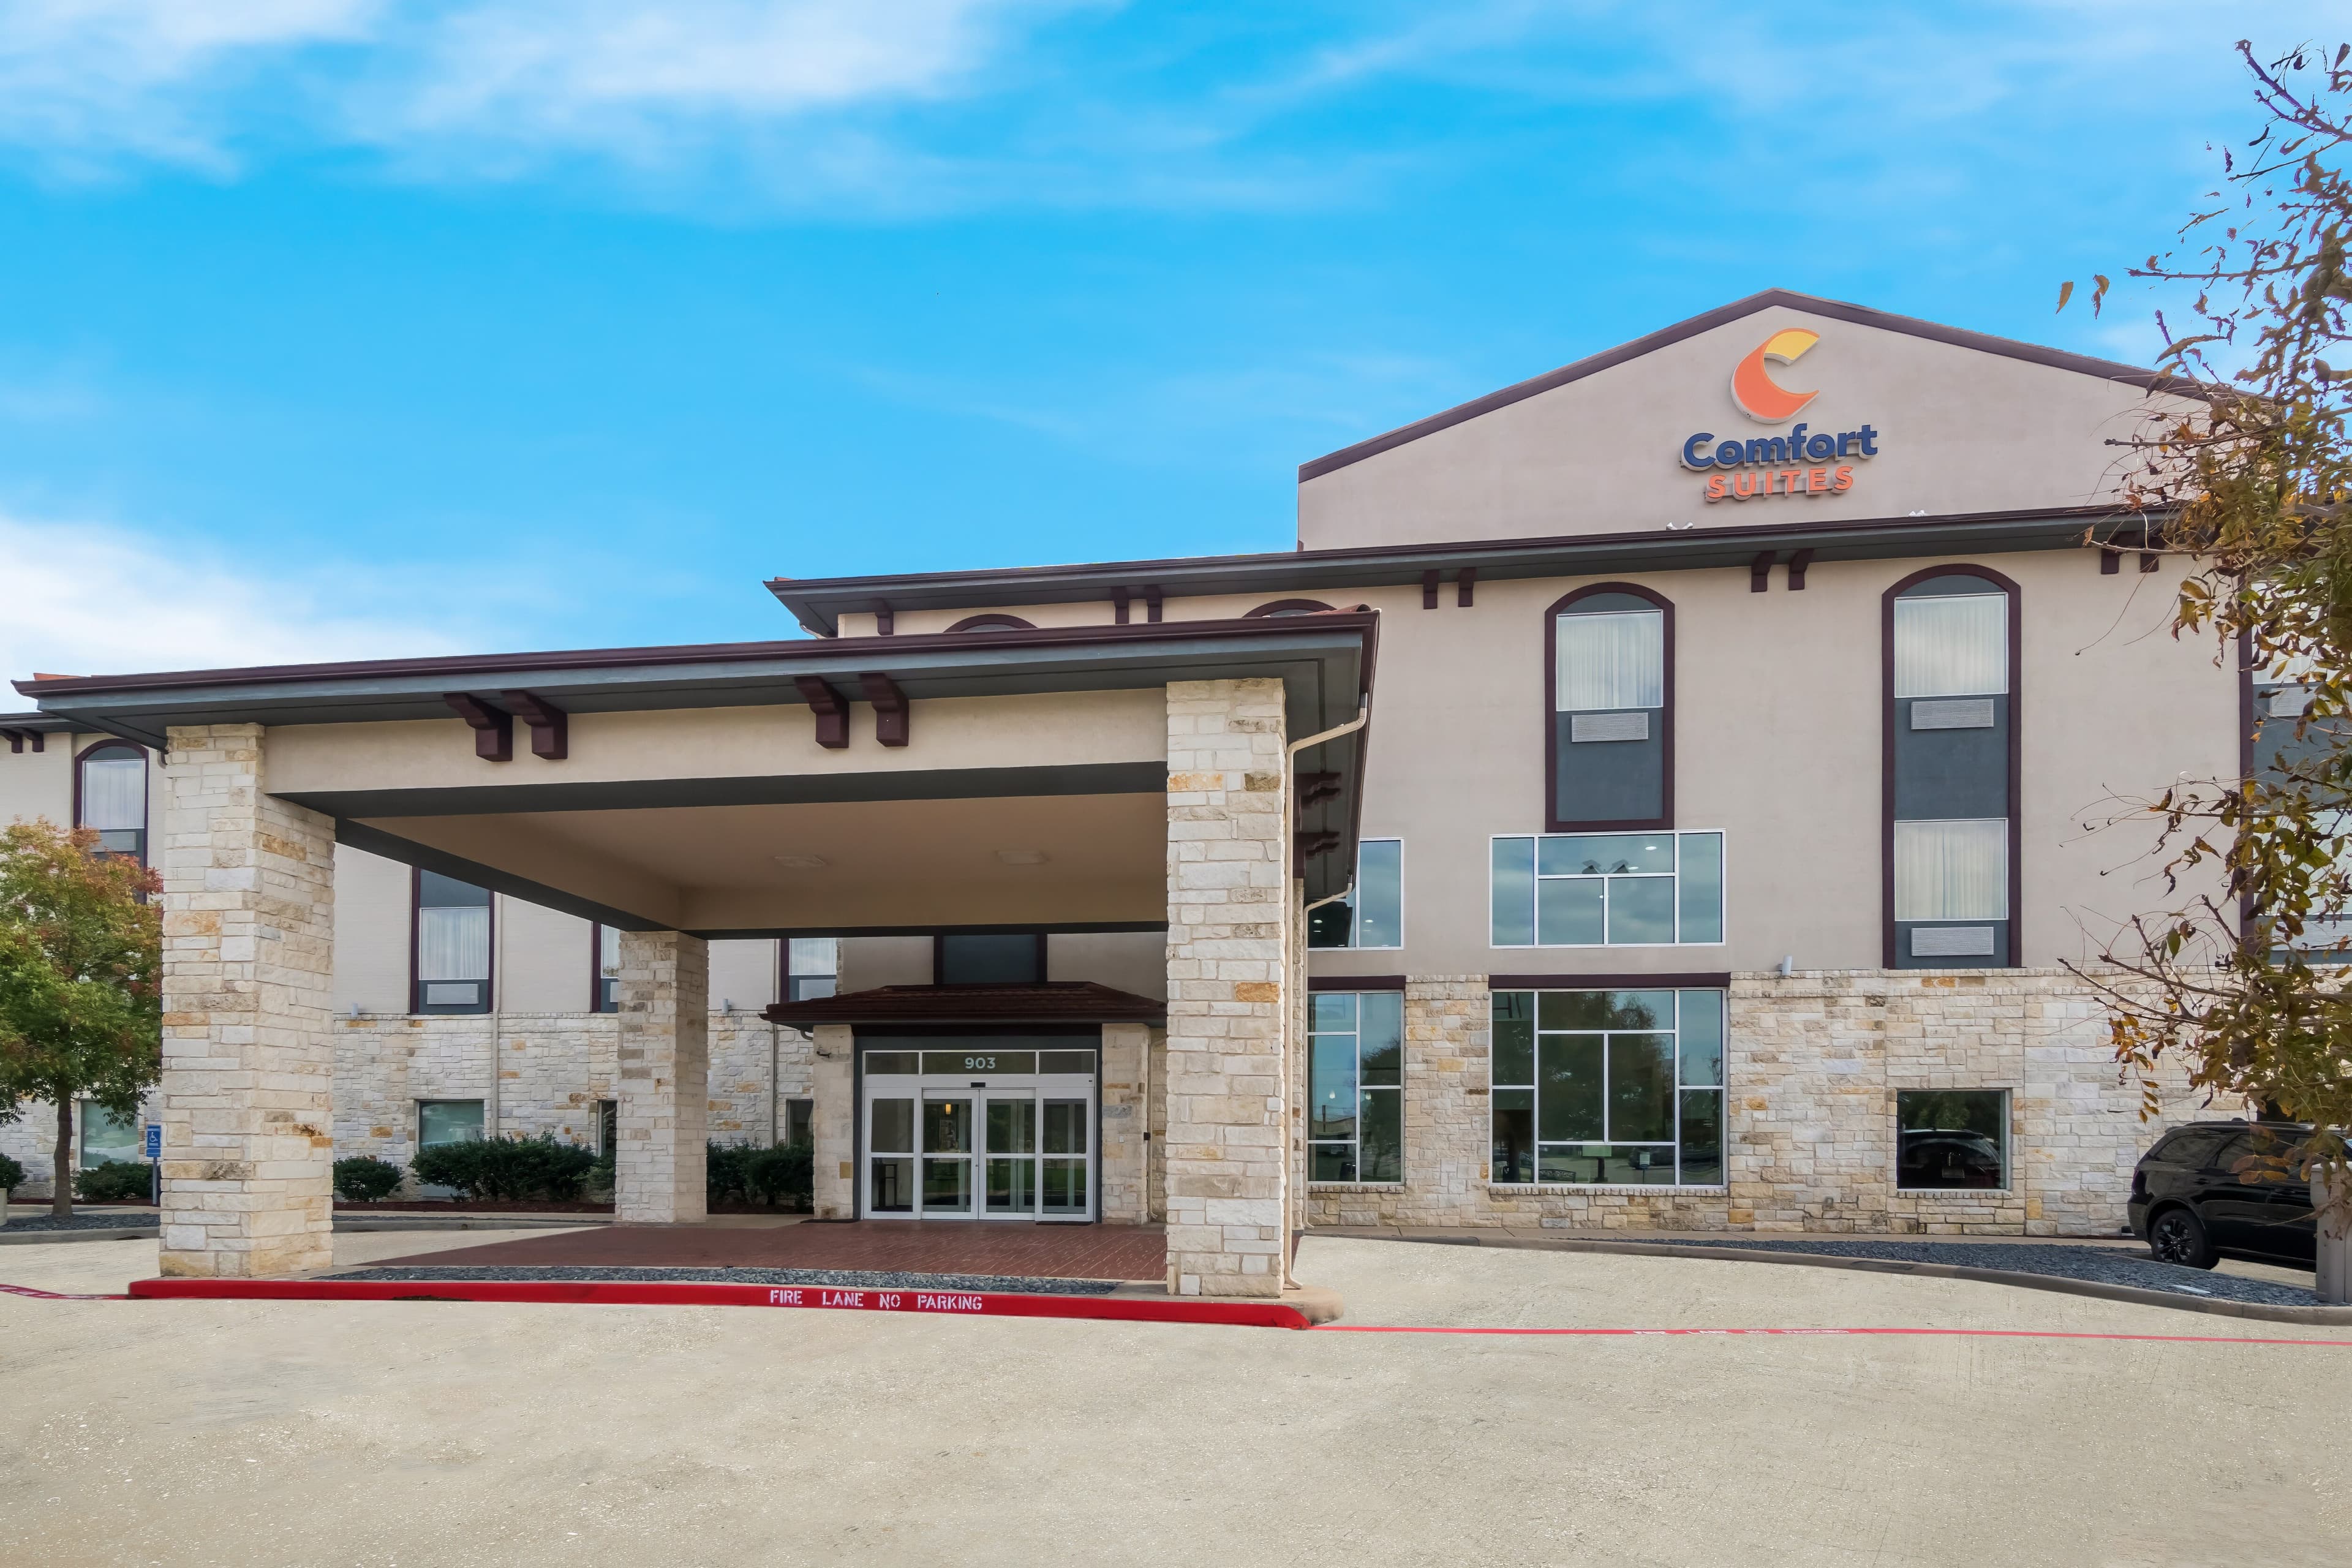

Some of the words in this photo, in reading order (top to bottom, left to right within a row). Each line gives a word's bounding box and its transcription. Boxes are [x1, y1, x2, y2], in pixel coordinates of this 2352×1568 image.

[1682, 423, 1878, 469] Comfort
[1706, 466, 1854, 500] SUITES
[965, 1057, 996, 1069] 903
[770, 1289, 803, 1305] FIRE
[822, 1291, 864, 1307] LANE
[879, 1293, 901, 1310] NO
[917, 1294, 983, 1311] PARKING
